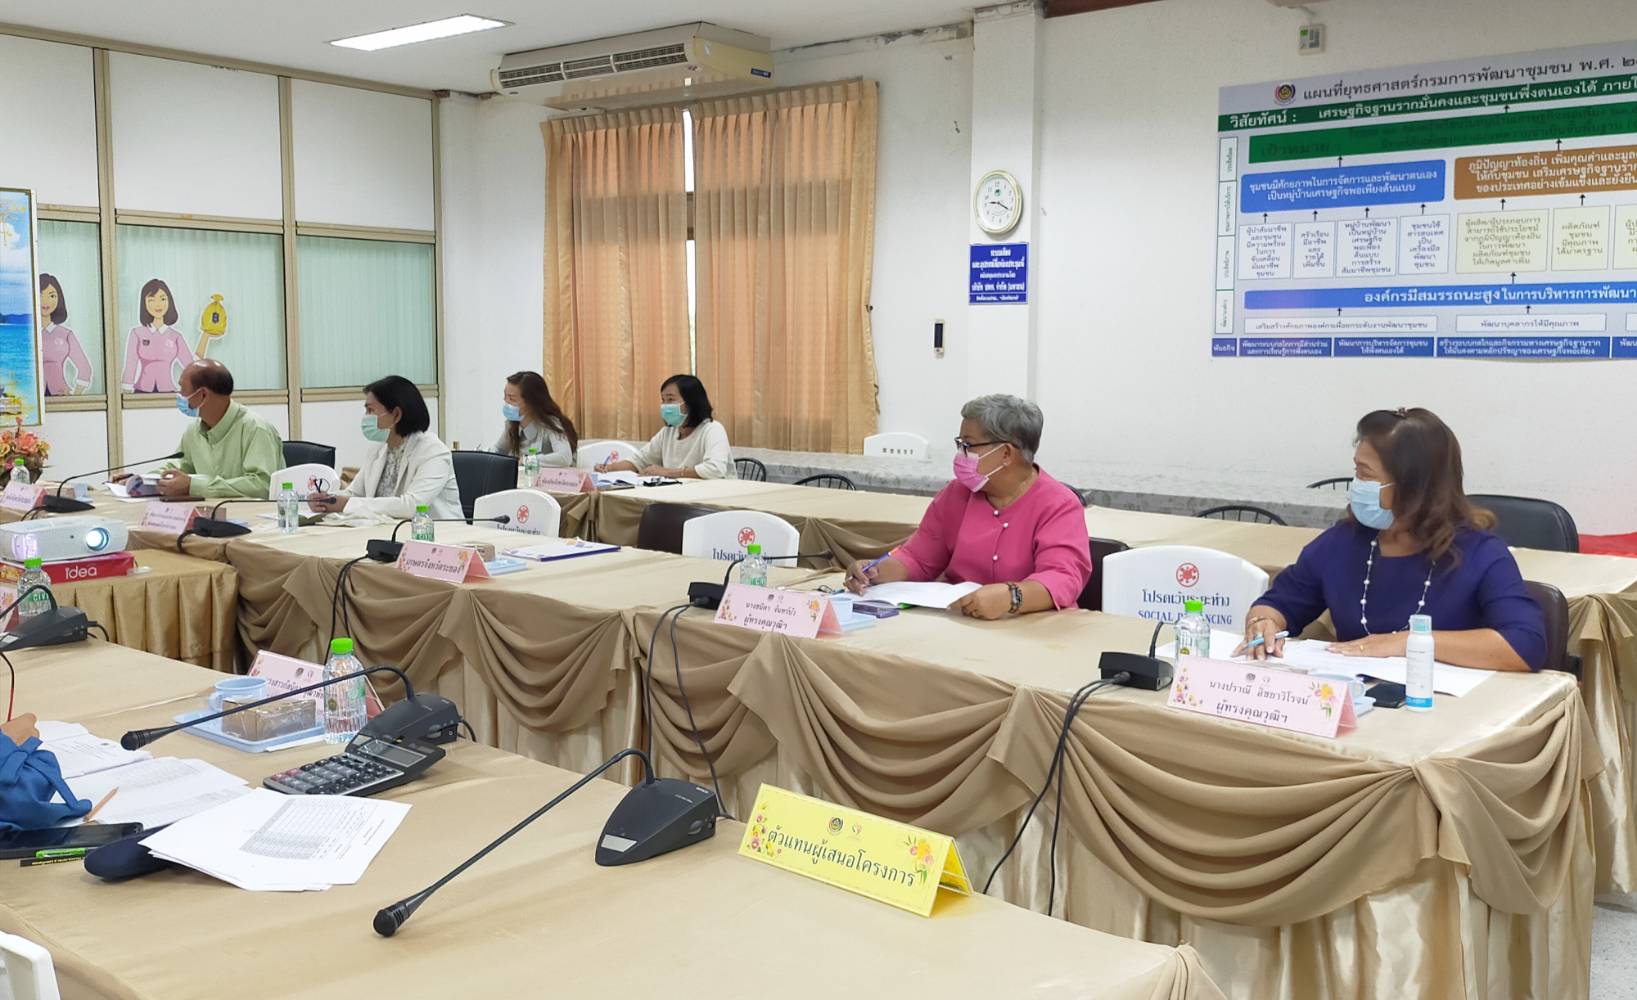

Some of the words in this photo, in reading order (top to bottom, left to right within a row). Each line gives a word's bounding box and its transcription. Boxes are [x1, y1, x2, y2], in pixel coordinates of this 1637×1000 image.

[1303, 61, 1572, 101] แผนที่ยุทธศาสตร์กรมการพัฒนาชุมชน
[1579, 57, 1615, 72] พ.ศ.
[1622, 55, 1637, 67] ๒
[1230, 110, 1287, 129] วิสัยทัศน์
[65, 565, 97, 580] idea
[767, 824, 916, 888] ตัวแทนผู้เสนอโครงการ
